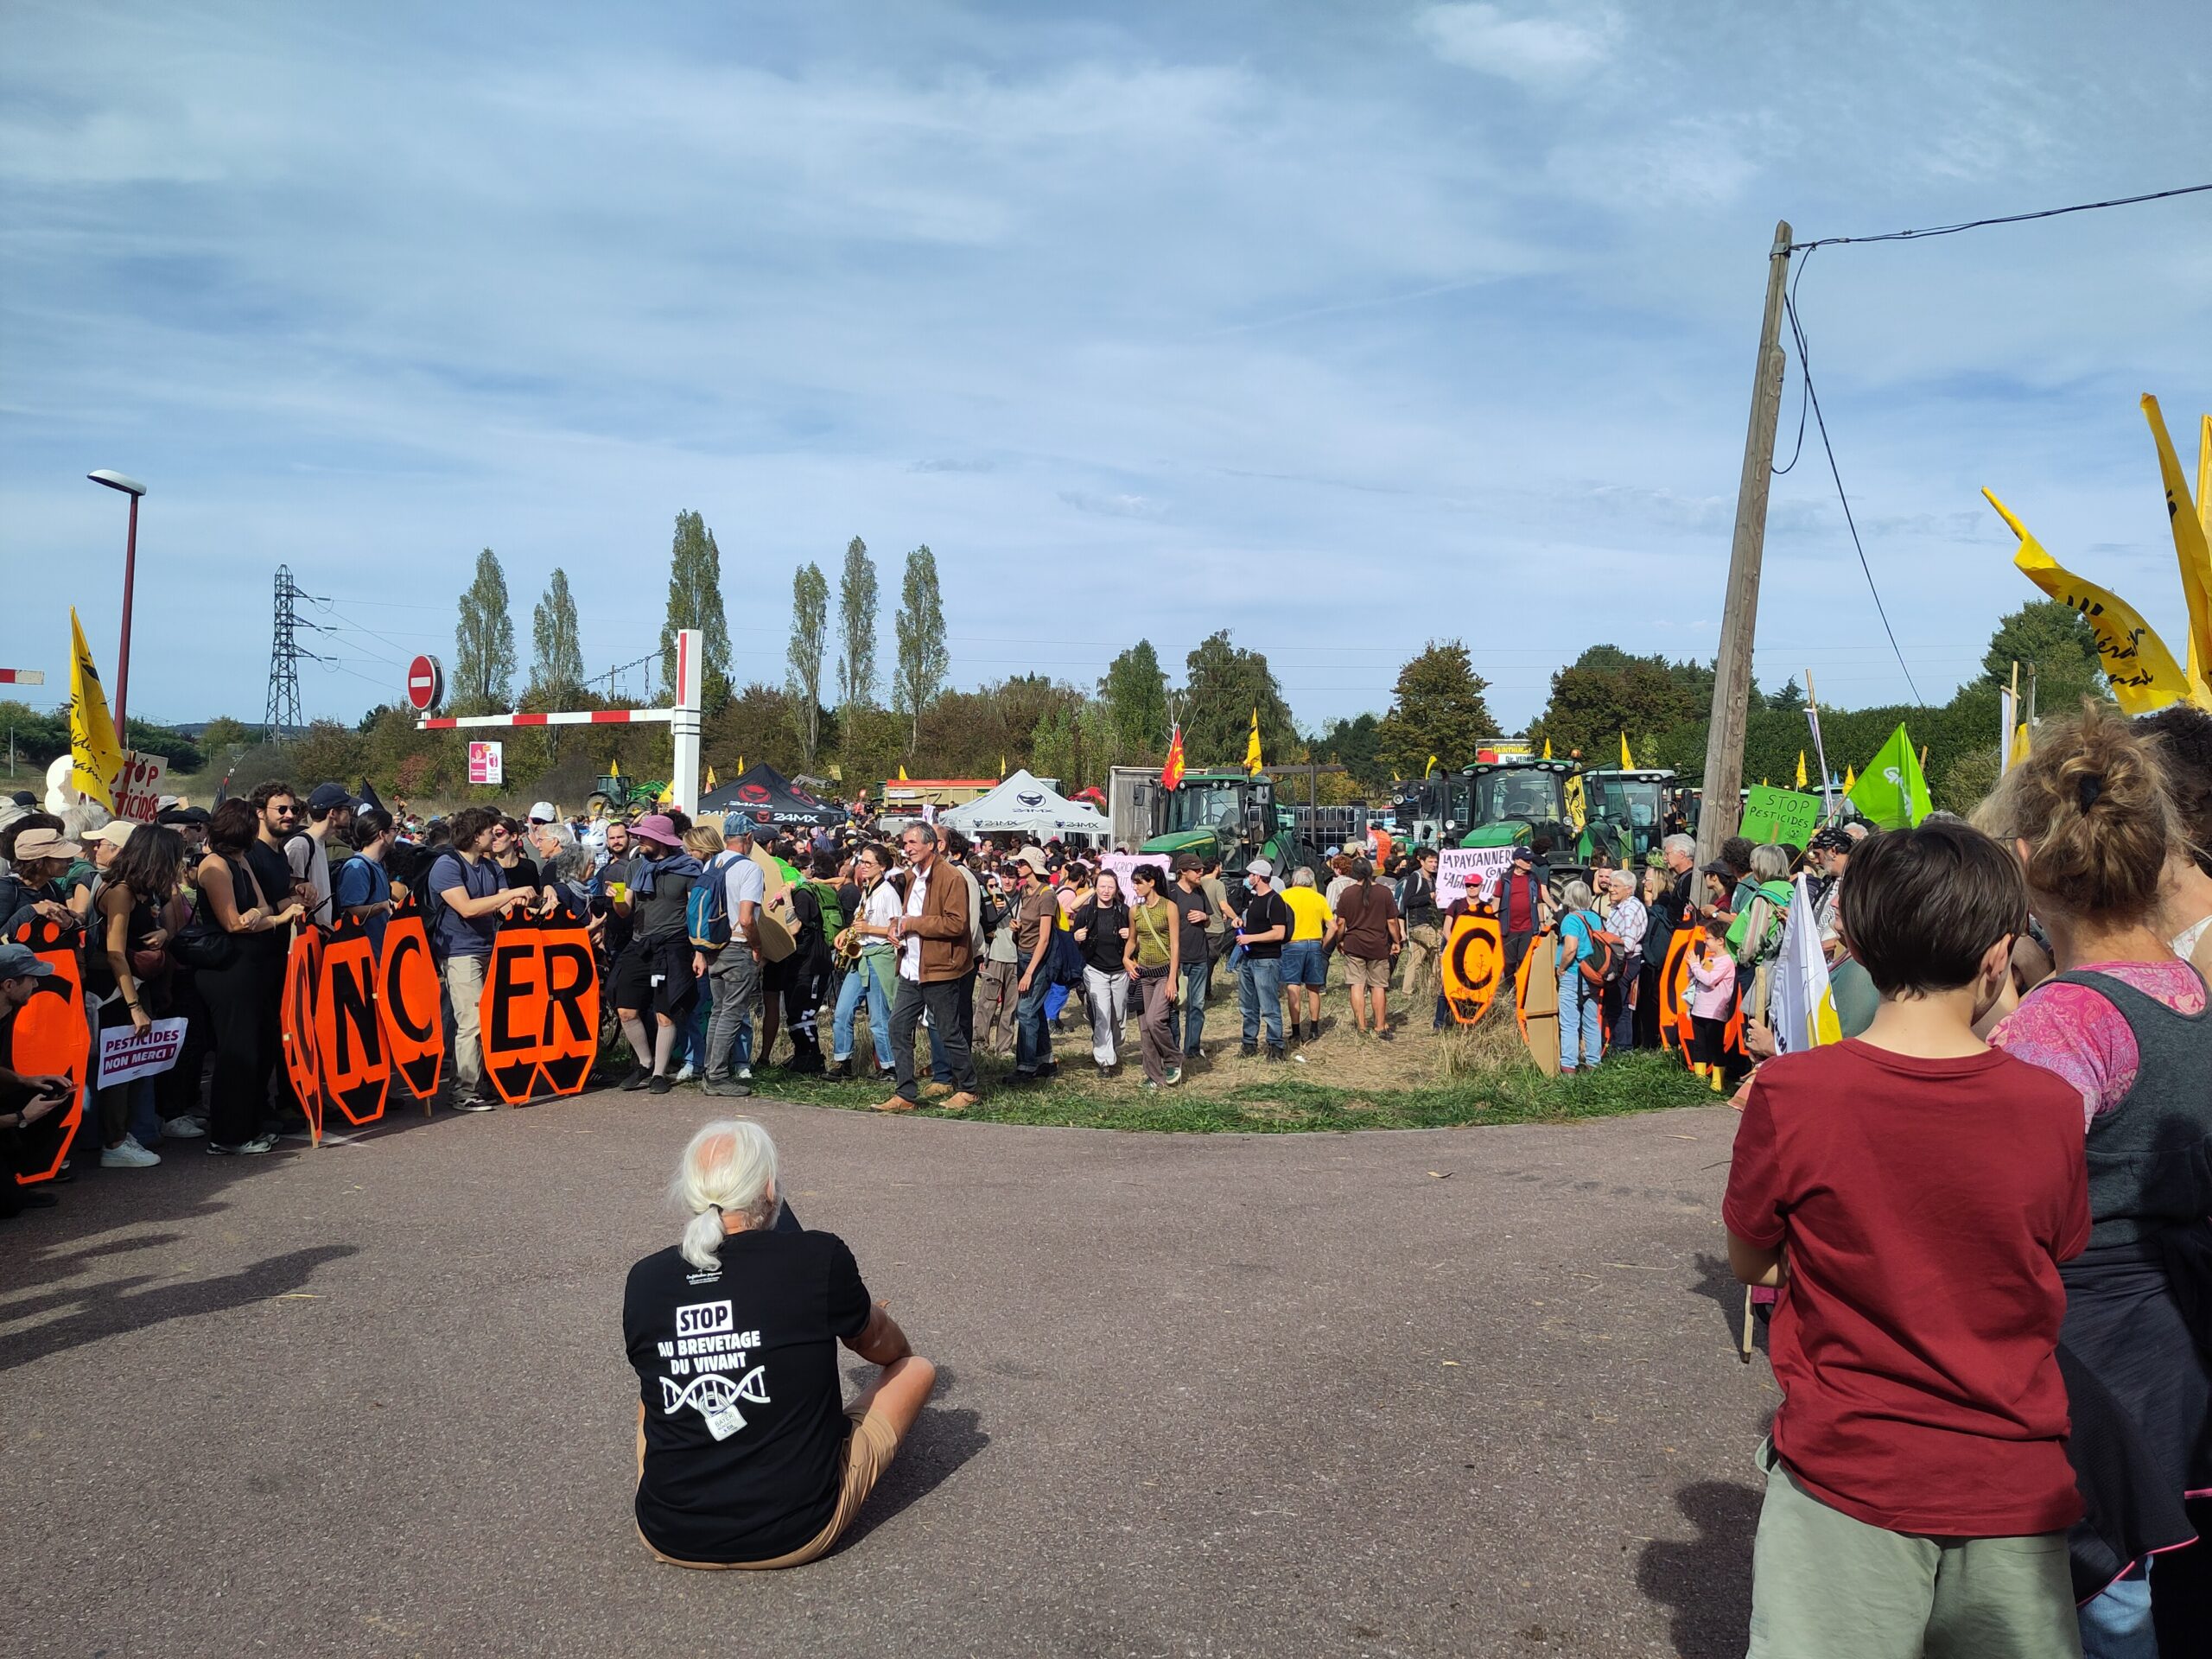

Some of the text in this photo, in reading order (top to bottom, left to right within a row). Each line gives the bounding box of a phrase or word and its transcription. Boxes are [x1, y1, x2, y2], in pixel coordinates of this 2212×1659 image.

[1766, 794, 1810, 814] STOP
[772, 813, 819, 823] 24MX
[1749, 806, 1809, 829] PESTICIDES
[1443, 854, 1453, 868] LA
[1452, 927, 1497, 991] C
[105, 1029, 180, 1052] PESTICIDES
[105, 1055, 130, 1071] NON
[131, 1048, 167, 1064] MERCI
[679, 1306, 728, 1332] STOP
[658, 1331, 761, 1357] AU BREVETAGE
[671, 1352, 747, 1375] DU VIVANT
